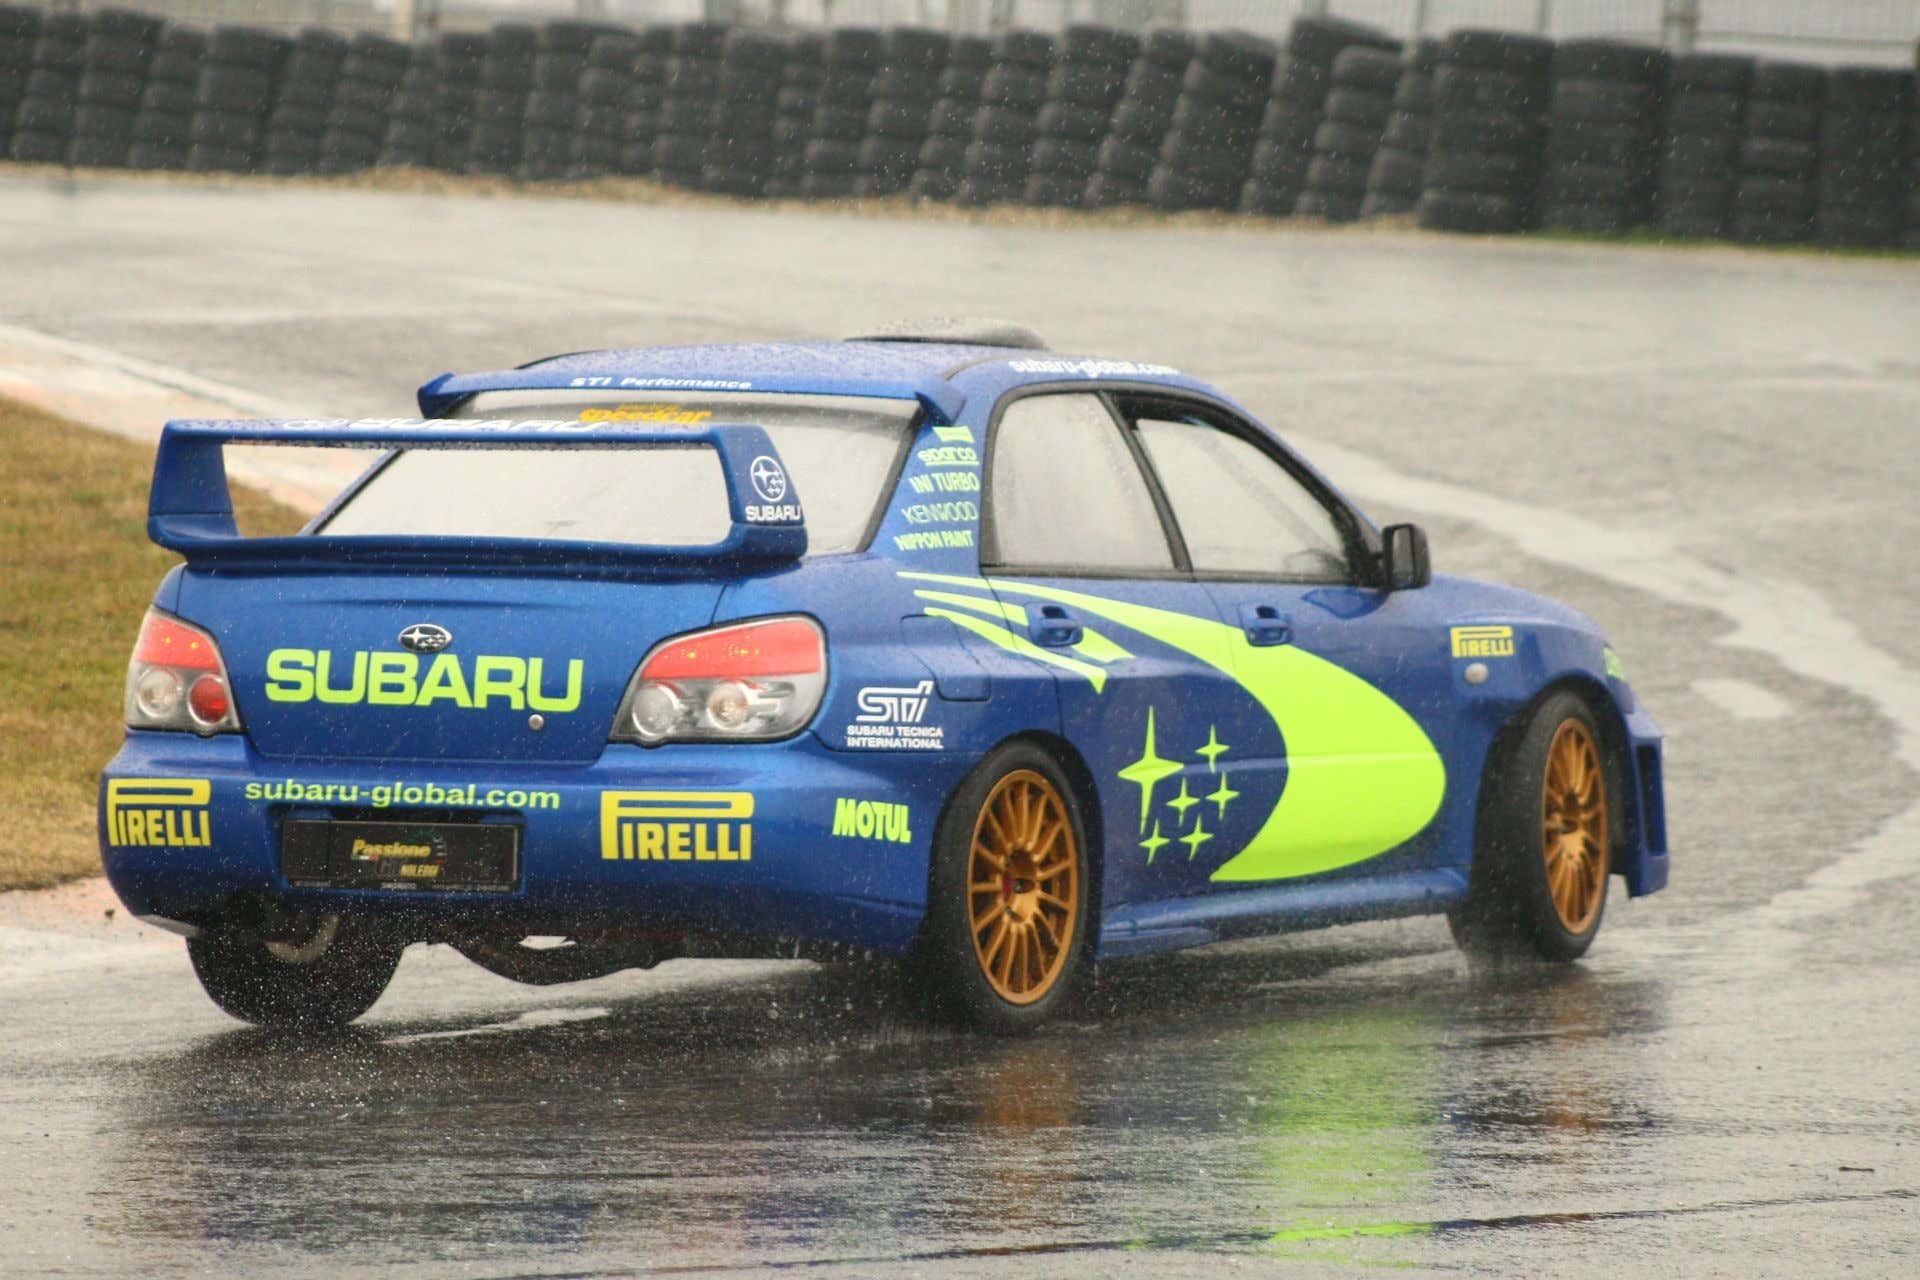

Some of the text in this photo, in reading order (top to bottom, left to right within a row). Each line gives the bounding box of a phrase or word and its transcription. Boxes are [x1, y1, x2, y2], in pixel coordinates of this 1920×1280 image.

[570, 377, 752, 389] STI Performance
[931, 472, 981, 492] TURBO
[745, 504, 801, 522] SUBARU
[901, 501, 978, 524] KENWOOD
[1450, 625, 1514, 658] PIRELLI
[265, 648, 585, 713] SUBARU
[847, 724, 944, 737] SUBARU TECNICA
[846, 737, 944, 749] INTERNATIONAL
[245, 779, 561, 810] subaru-global.com
[106, 778, 212, 847] PIRELLI
[832, 798, 912, 843] MOTUL
[601, 790, 755, 861] PIRELLI
[351, 839, 432, 858] Passione
